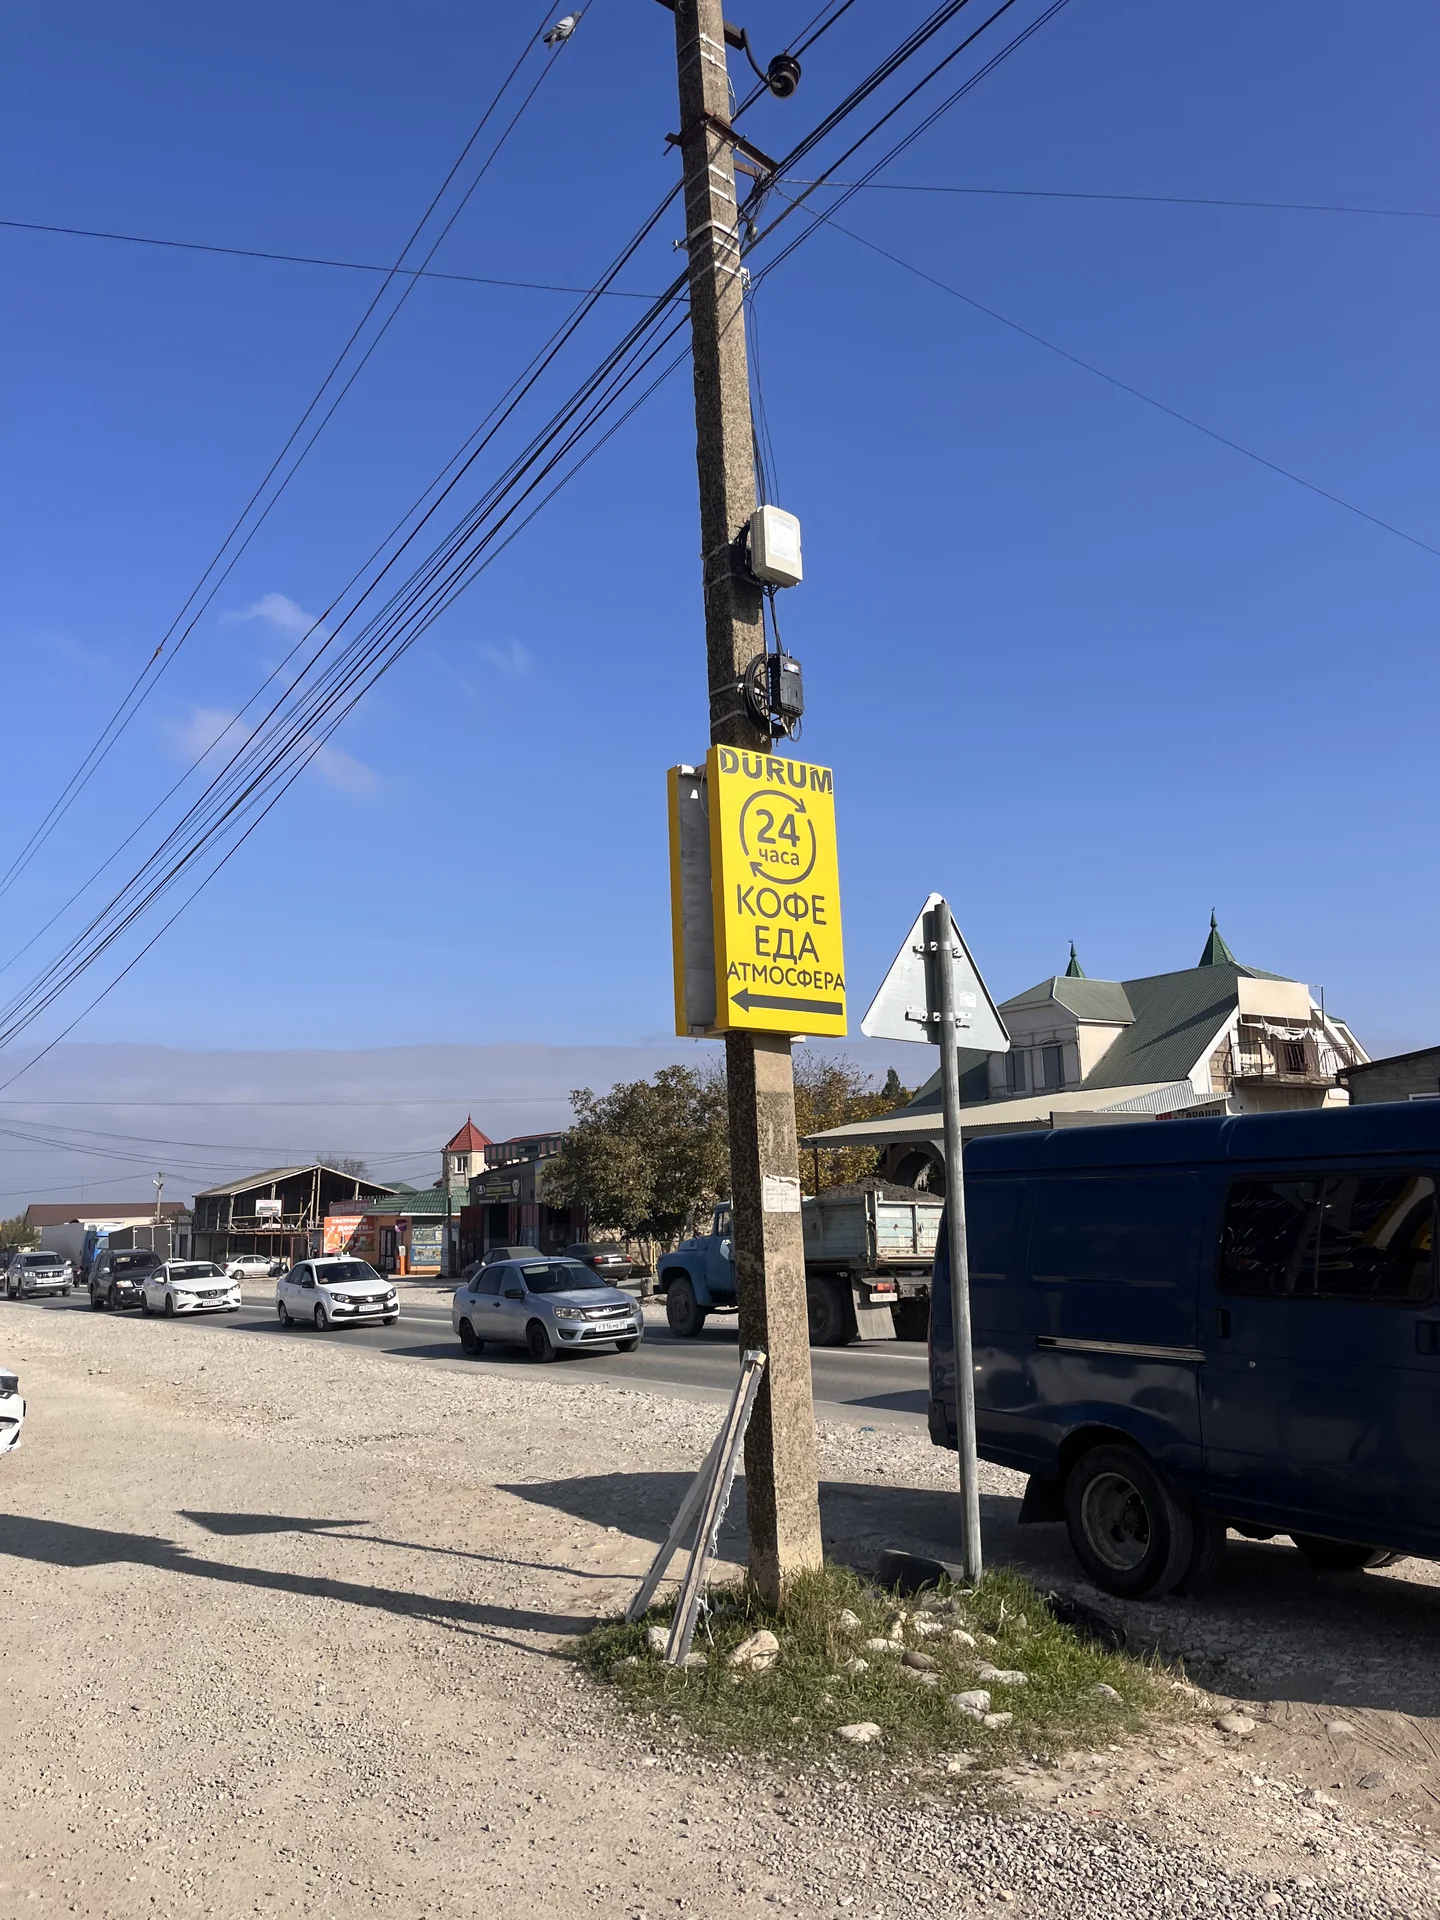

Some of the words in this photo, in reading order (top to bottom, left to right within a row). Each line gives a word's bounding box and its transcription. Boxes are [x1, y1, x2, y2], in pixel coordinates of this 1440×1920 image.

[755, 808, 801, 848] 24
[758, 848, 800, 866] часа
[736, 883, 827, 926] КОФЕ
[755, 925, 820, 966] ЕДА
[726, 961, 846, 992] АТМОСФЕРА
